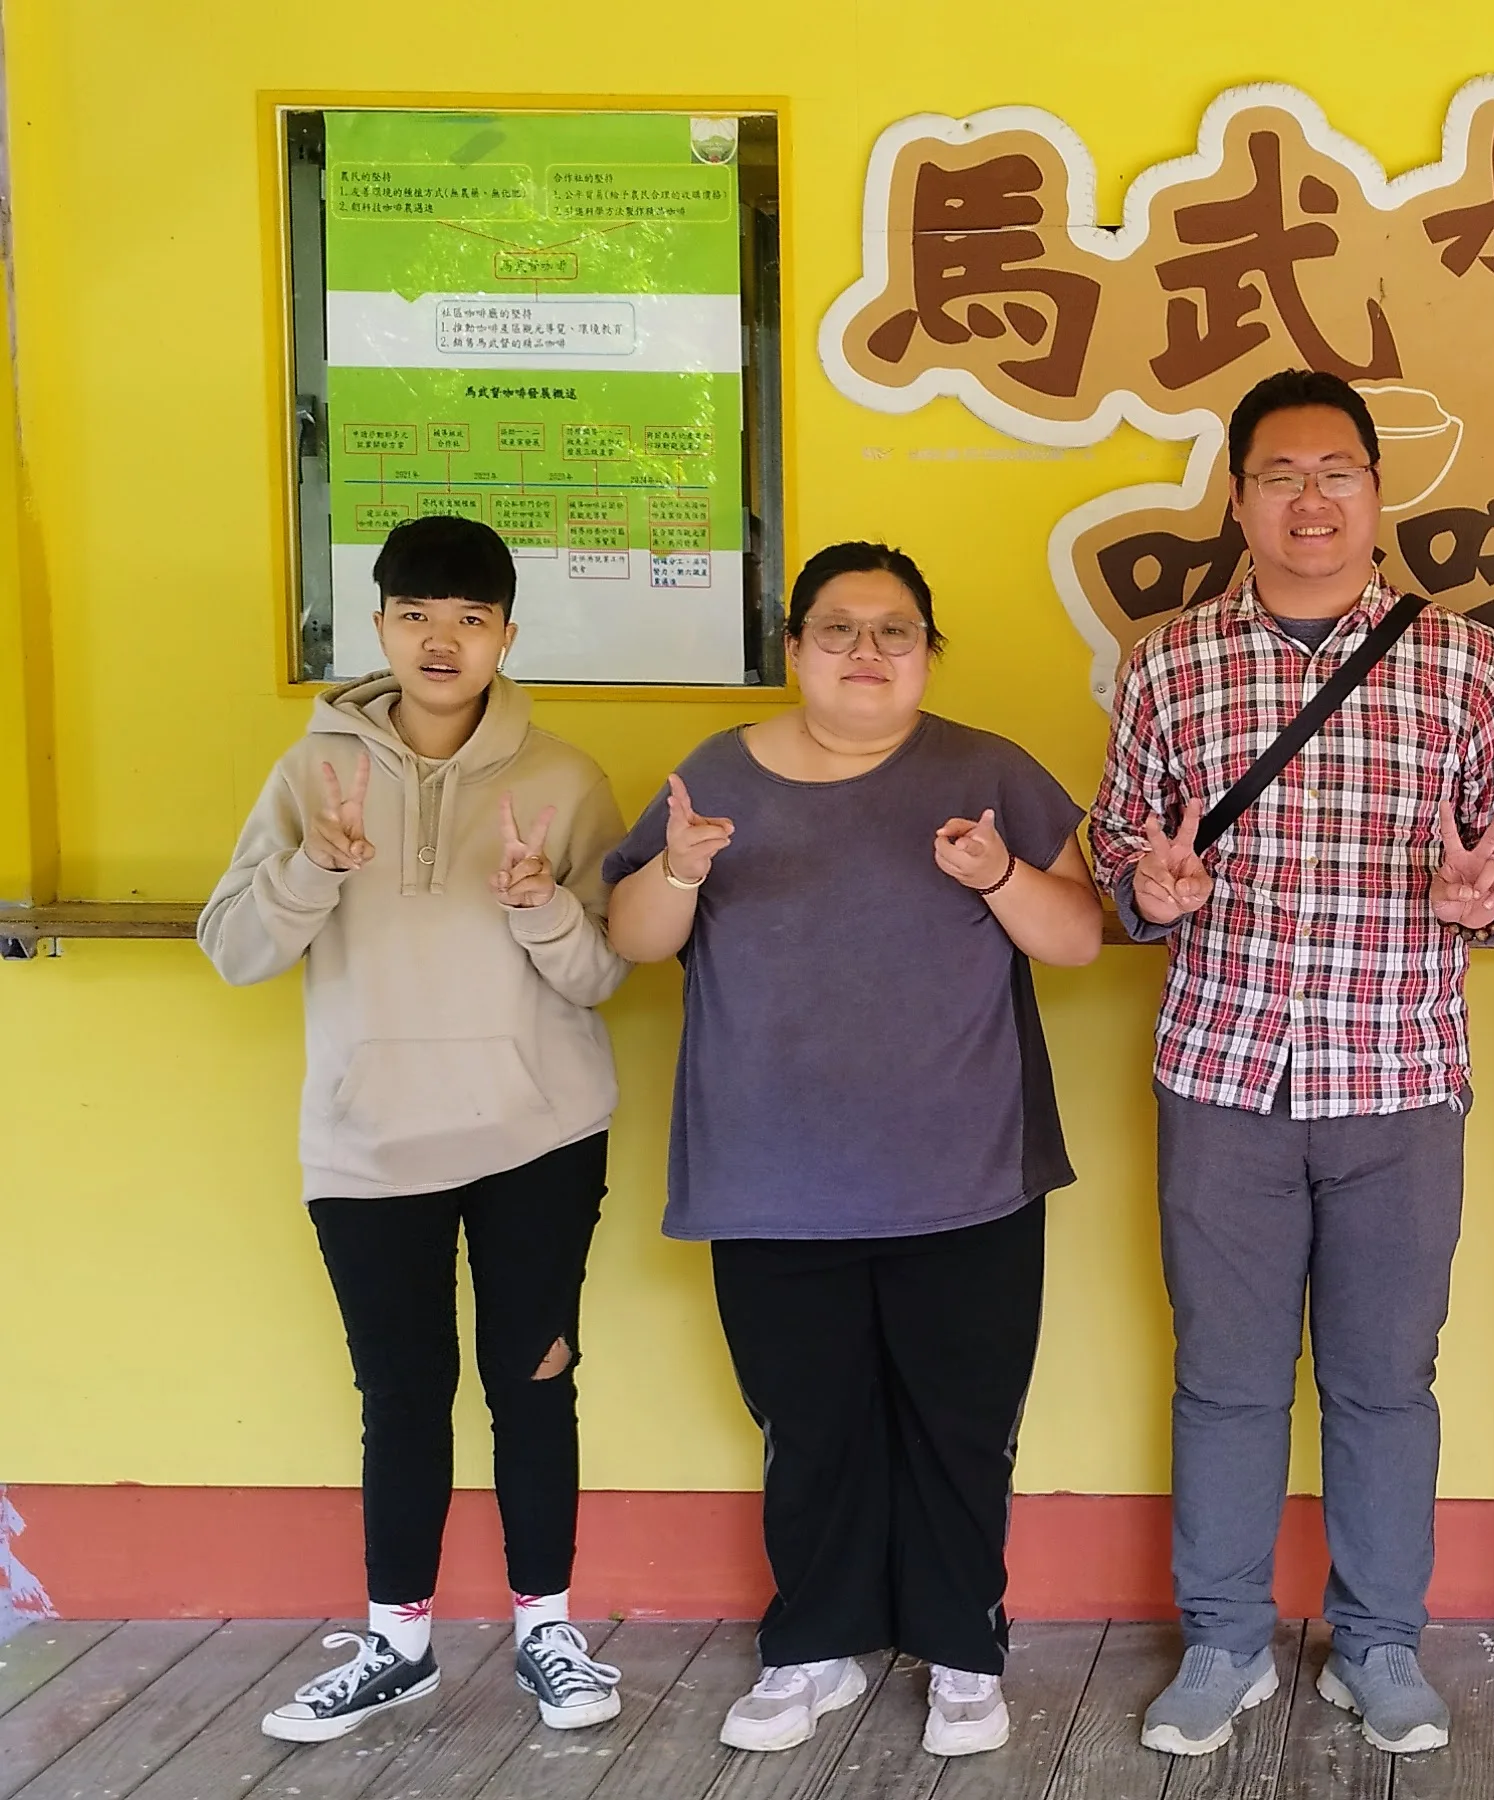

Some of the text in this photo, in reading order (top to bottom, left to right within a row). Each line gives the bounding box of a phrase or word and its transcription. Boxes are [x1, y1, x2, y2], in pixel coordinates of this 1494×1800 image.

[553, 173, 613, 184] 合作社的堅持
